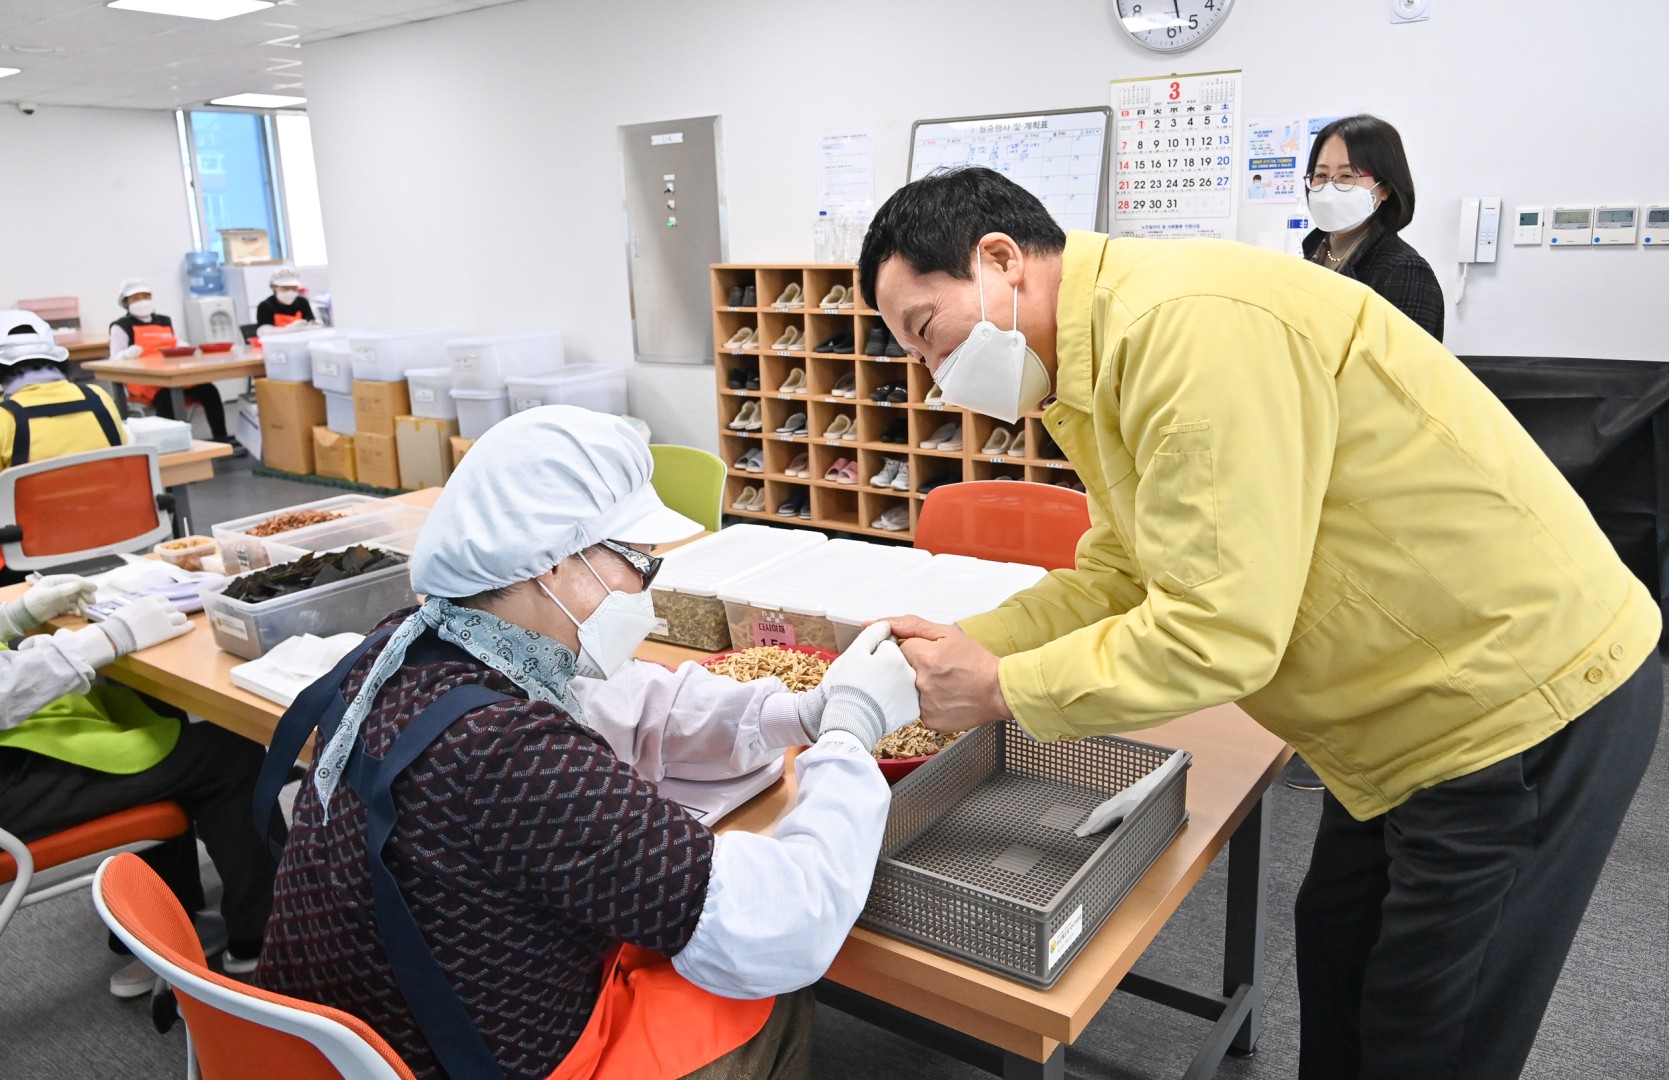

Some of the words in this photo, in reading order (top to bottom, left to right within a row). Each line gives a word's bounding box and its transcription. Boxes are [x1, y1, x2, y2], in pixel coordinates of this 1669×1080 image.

[1189, 14, 1198, 30] 5
[1169, 82, 1180, 100] 3
[979, 124, 1010, 134] 월중행사
[1024, 121, 1048, 130] 계획표
[1154, 120, 1160, 128] 2
[1171, 119, 1176, 127] 3
[1204, 116, 1210, 125] 5
[1122, 142, 1127, 150] 7
[1137, 141, 1143, 149] 8
[1154, 140, 1159, 148] 9
[1168, 139, 1178, 147] 10
[1185, 138, 1195, 146] 11
[1201, 137, 1212, 145] 12
[1218, 136, 1229, 144] 13
[1135, 161, 1145, 169] 15
[1151, 160, 1161, 168] 16
[1184, 158, 1194, 167] 18
[1201, 158, 1211, 166] 19
[1217, 156, 1229, 165] 20
[1119, 182, 1129, 190] 21
[1134, 181, 1145, 189] 22
[1150, 180, 1162, 188] 23
[1166, 180, 1178, 188] 24
[1183, 179, 1195, 187] 25
[1199, 178, 1211, 186] 26
[1217, 177, 1229, 185] 27
[1118, 201, 1129, 209] 28
[1133, 201, 1145, 209] 29
[1149, 200, 1161, 209] 30
[1166, 200, 1177, 208] 31
[758, 623, 785, 634] 다시마채
